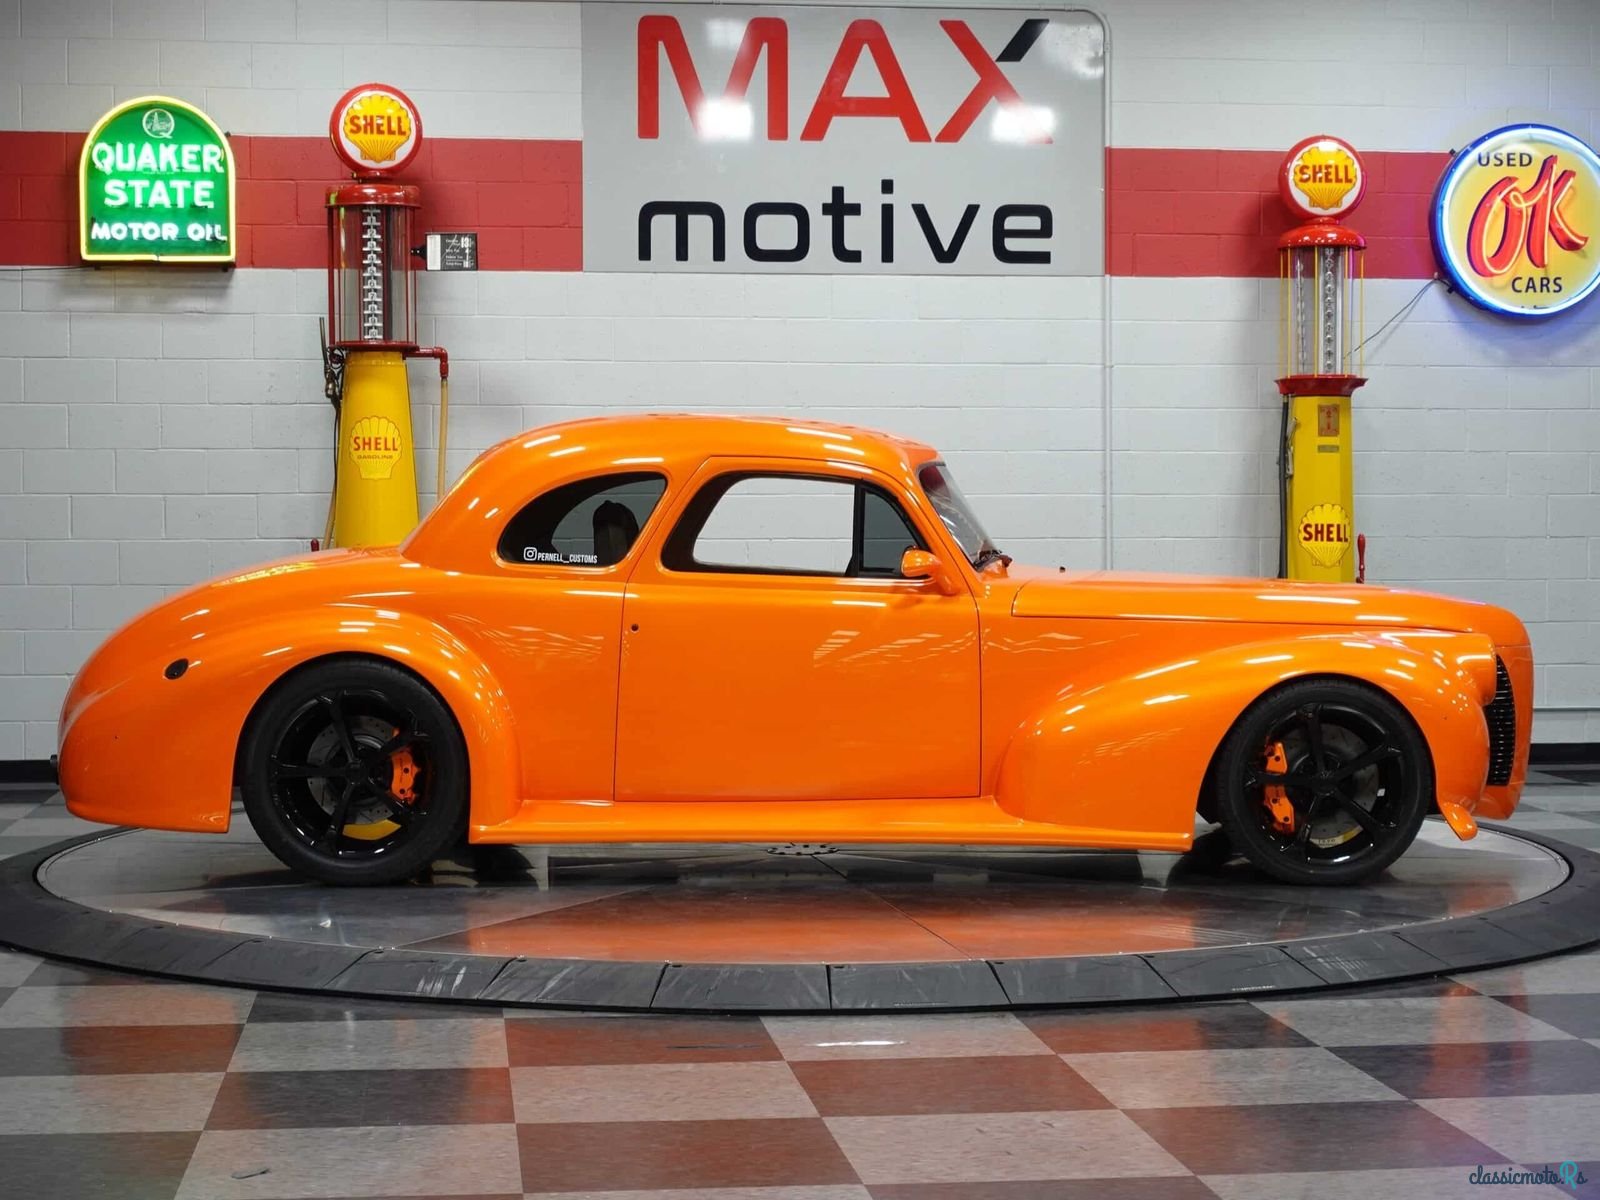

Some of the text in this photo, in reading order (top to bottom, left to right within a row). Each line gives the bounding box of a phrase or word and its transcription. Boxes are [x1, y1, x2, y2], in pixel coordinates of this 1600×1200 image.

[637, 15, 1053, 143] MAX
[349, 114, 407, 137] SHELL
[91, 141, 225, 175] QUAKER
[1477, 151, 1533, 168] USED
[1298, 164, 1354, 184] SHELL
[103, 178, 215, 209] STATE
[638, 179, 1053, 264] motive
[1466, 154, 1590, 278] OK
[91, 221, 228, 242] MOTOR OIL
[1511, 276, 1563, 293] CARS
[353, 436, 399, 452] SHELL
[1302, 523, 1349, 543] SHELL
